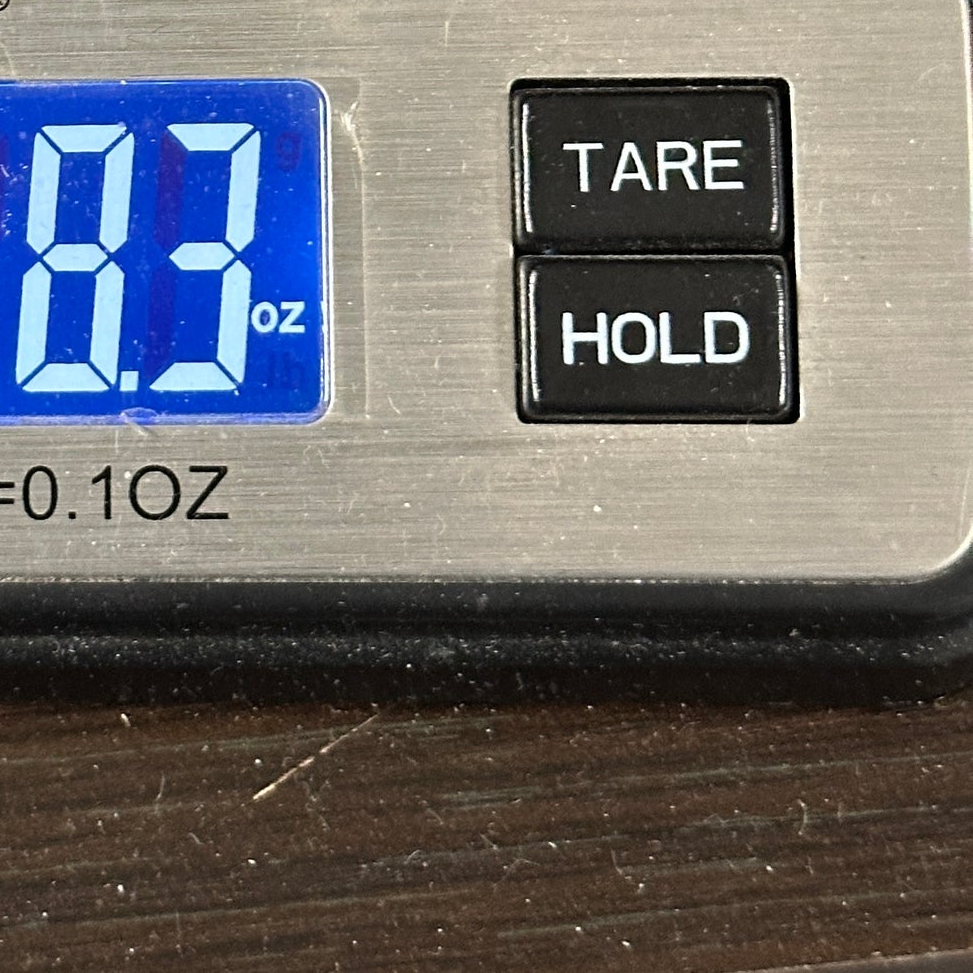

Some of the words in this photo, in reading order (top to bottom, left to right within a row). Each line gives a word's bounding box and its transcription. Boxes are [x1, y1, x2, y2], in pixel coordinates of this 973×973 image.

[562, 139, 745, 193] TARE
[251, 301, 306, 334] oz
[561, 311, 751, 365] HOLD
